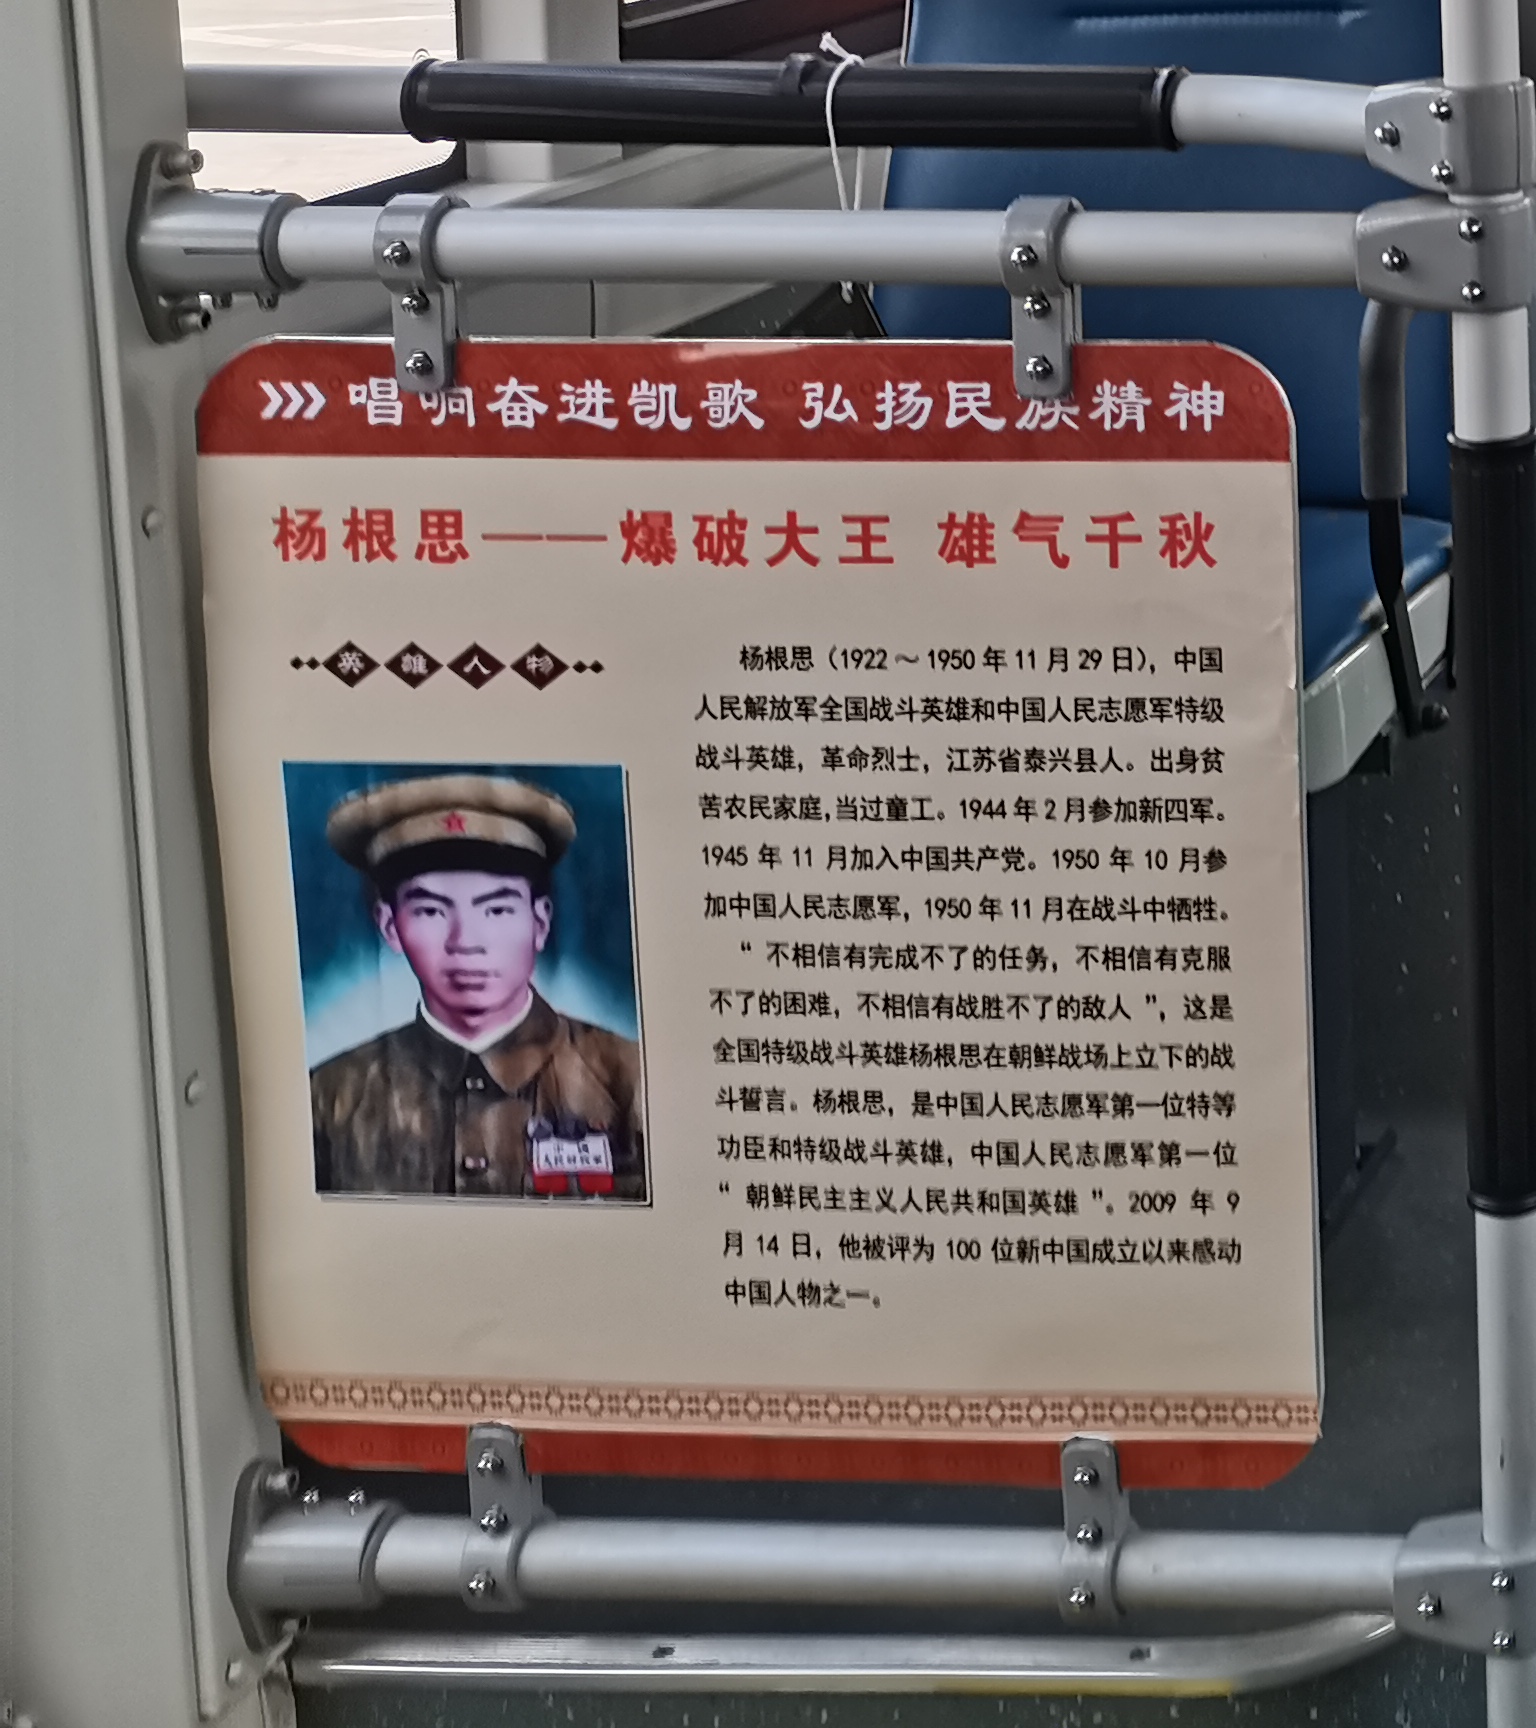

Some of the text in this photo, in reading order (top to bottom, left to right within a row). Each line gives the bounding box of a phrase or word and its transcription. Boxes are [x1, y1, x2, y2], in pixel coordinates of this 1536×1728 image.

[348, 376, 1227, 435] 唱响奋进凯歌 弘扬民族精神
[937, 508, 1220, 573] 雄气千秋
